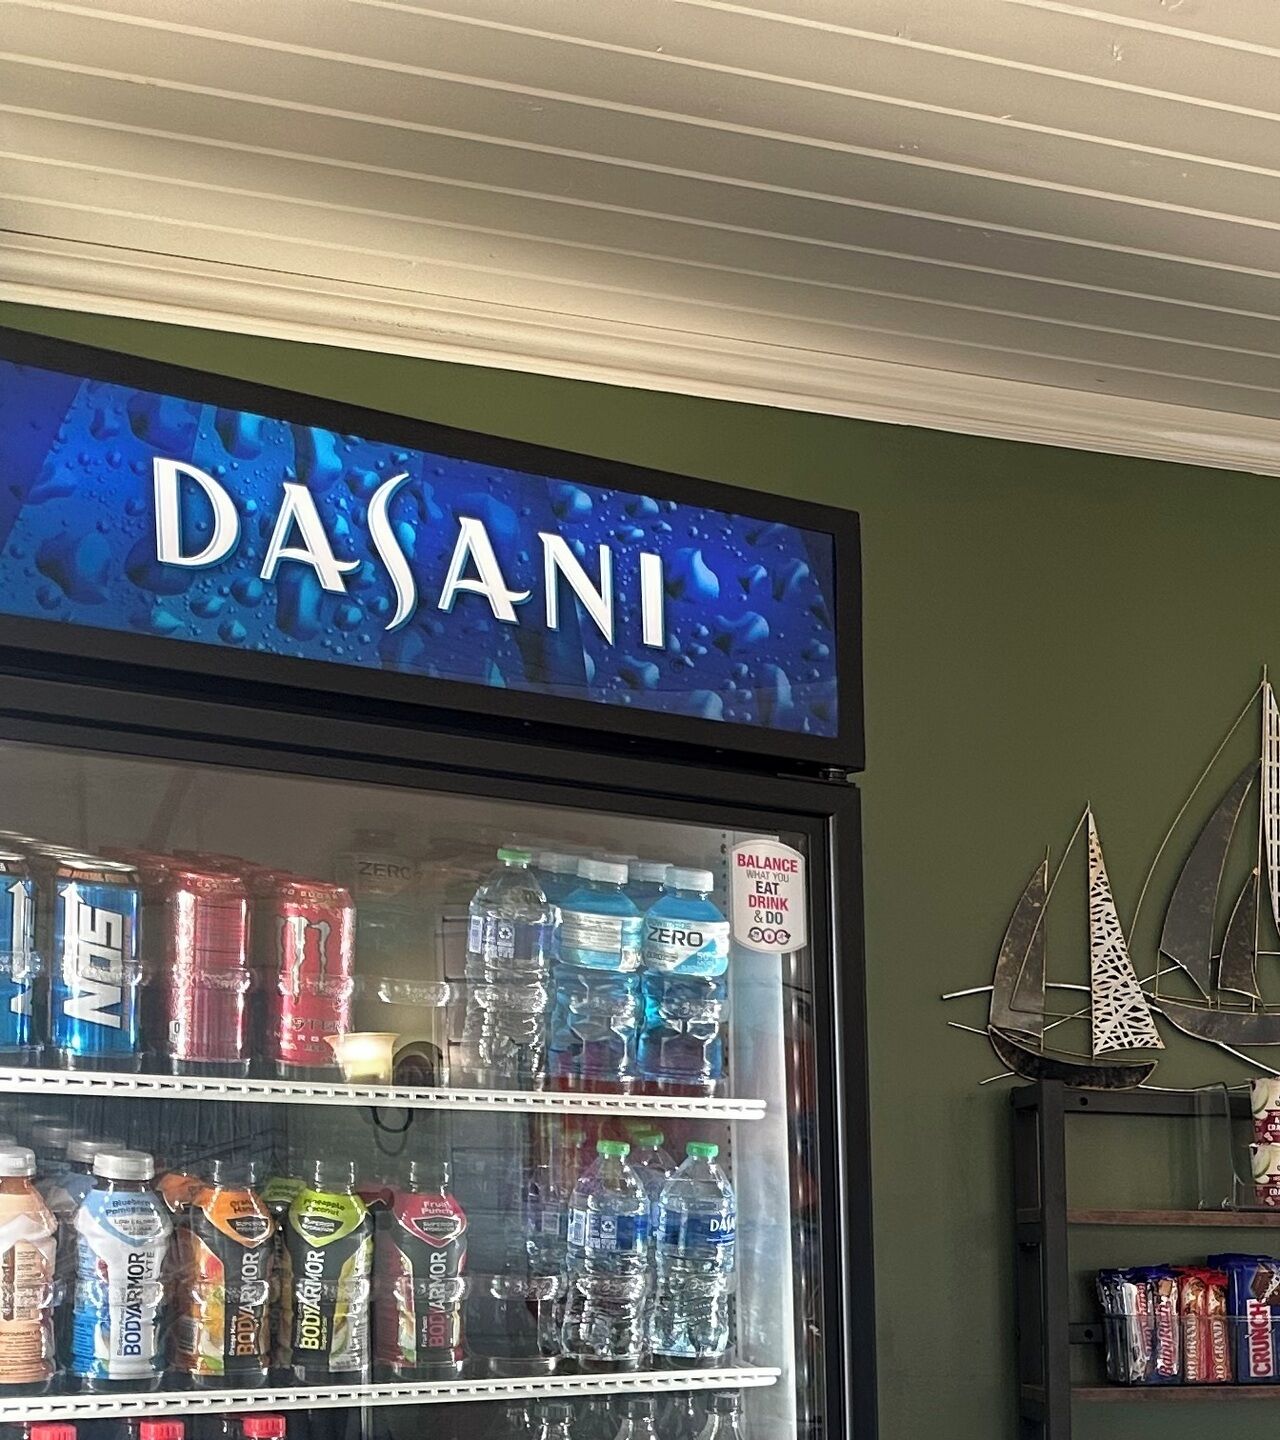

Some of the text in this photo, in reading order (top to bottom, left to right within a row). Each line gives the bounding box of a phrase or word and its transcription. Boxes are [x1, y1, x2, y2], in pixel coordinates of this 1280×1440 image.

[151, 457, 665, 649] DASANI
[737, 853, 798, 873] BALANCE
[746, 869, 790, 883] WHAT YOU
[756, 881, 779, 895] EAT
[748, 894, 789, 911] DRINK
[754, 910, 784, 925] & DO
[647, 927, 703, 948] ZERO
[64, 903, 123, 1030] NOS
[303, 1199, 345, 1210] Pineapple
[313, 1204, 340, 1216] Coconut
[421, 1207, 453, 1215] Punch
[423, 1200, 450, 1209] Fruit
[145, 1251, 155, 1279] LYTE
[124, 1252, 146, 1356] BODYARMOR
[237, 1251, 260, 1356] BODYARMOR
[299, 1250, 325, 1351] BODYARMOR
[428, 1251, 448, 1347] BODYARMOR
[1251, 1301, 1271, 1376] CRUNCH
